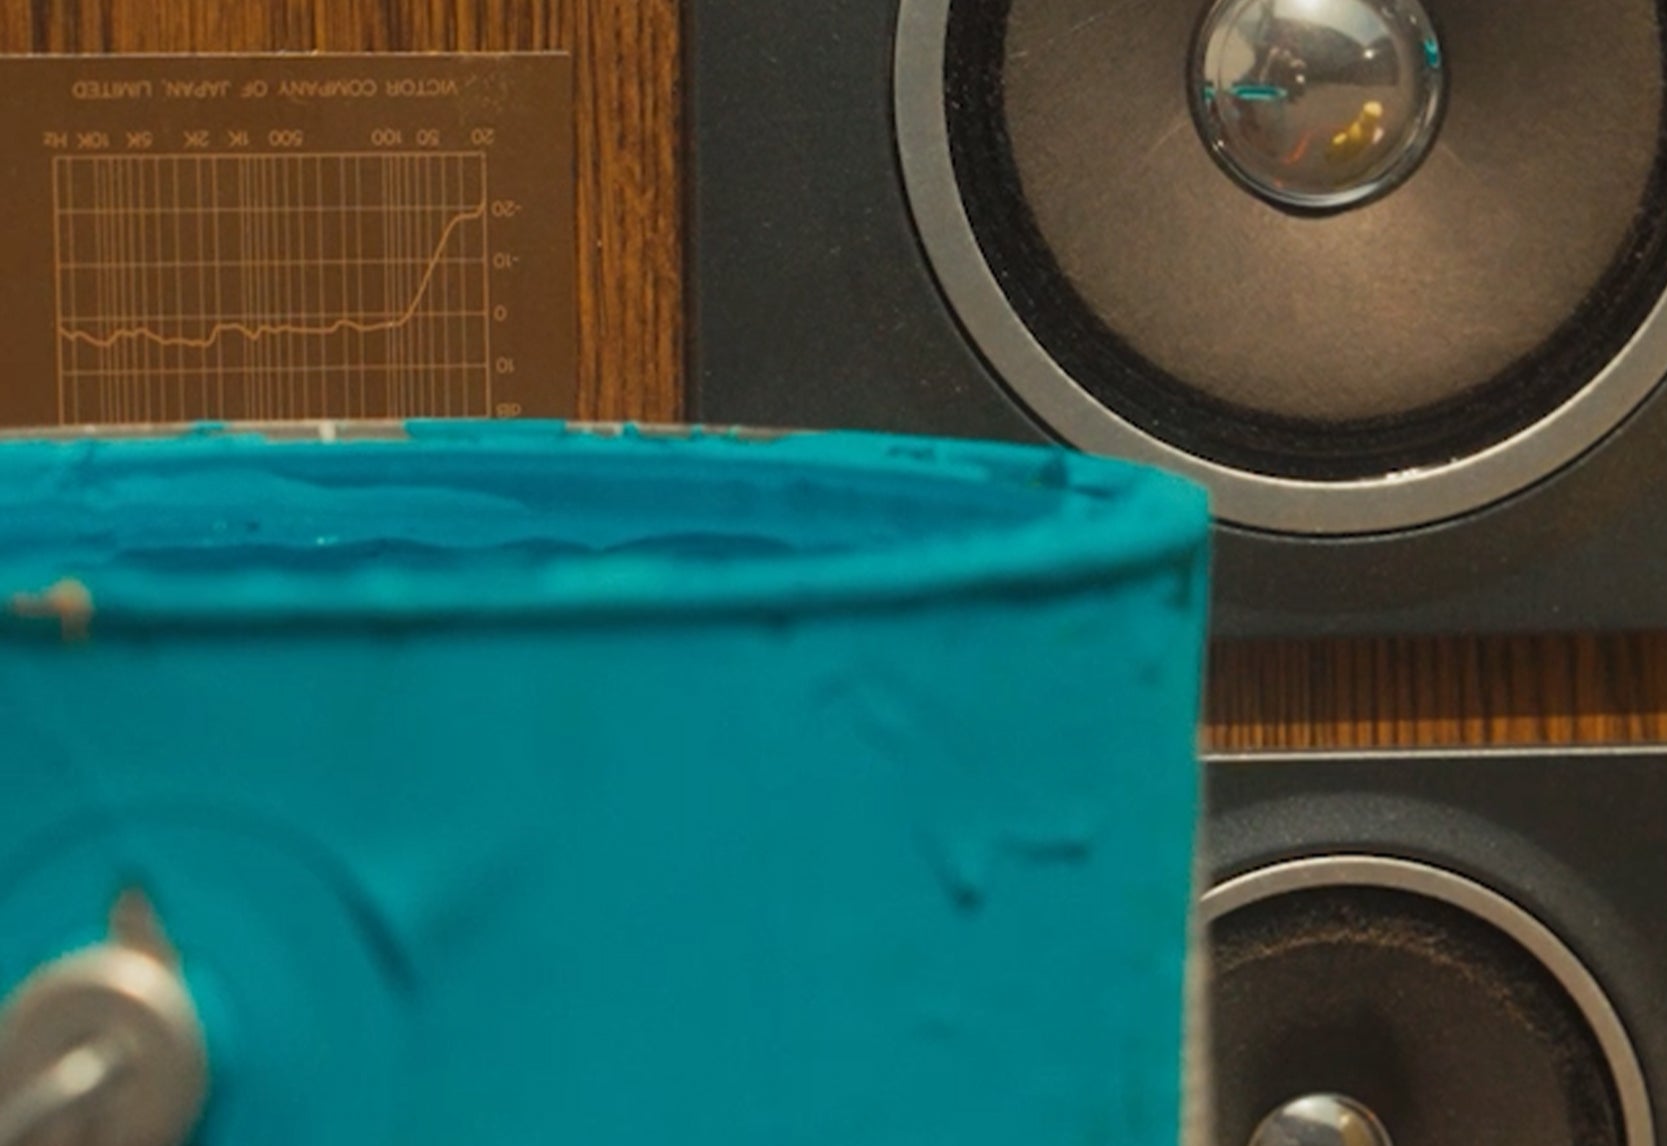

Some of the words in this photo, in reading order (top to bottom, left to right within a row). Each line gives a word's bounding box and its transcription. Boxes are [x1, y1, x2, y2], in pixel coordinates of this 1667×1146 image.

[71, 79, 150, 98] LIMITED
[241, 79, 268, 98] OF
[278, 78, 377, 97] COMPANY
[385, 78, 459, 97] VICTOR
[77, 130, 109, 149] 10K
[184, 129, 210, 147] 2K
[228, 129, 249, 147] 1K
[269, 128, 303, 146] 500
[371, 128, 403, 146] 100
[416, 128, 440, 146] 50
[471, 128, 495, 145] 20
[491, 200, 522, 217] -20
[493, 252, 519, 269] -10
[496, 357, 514, 373] 10
